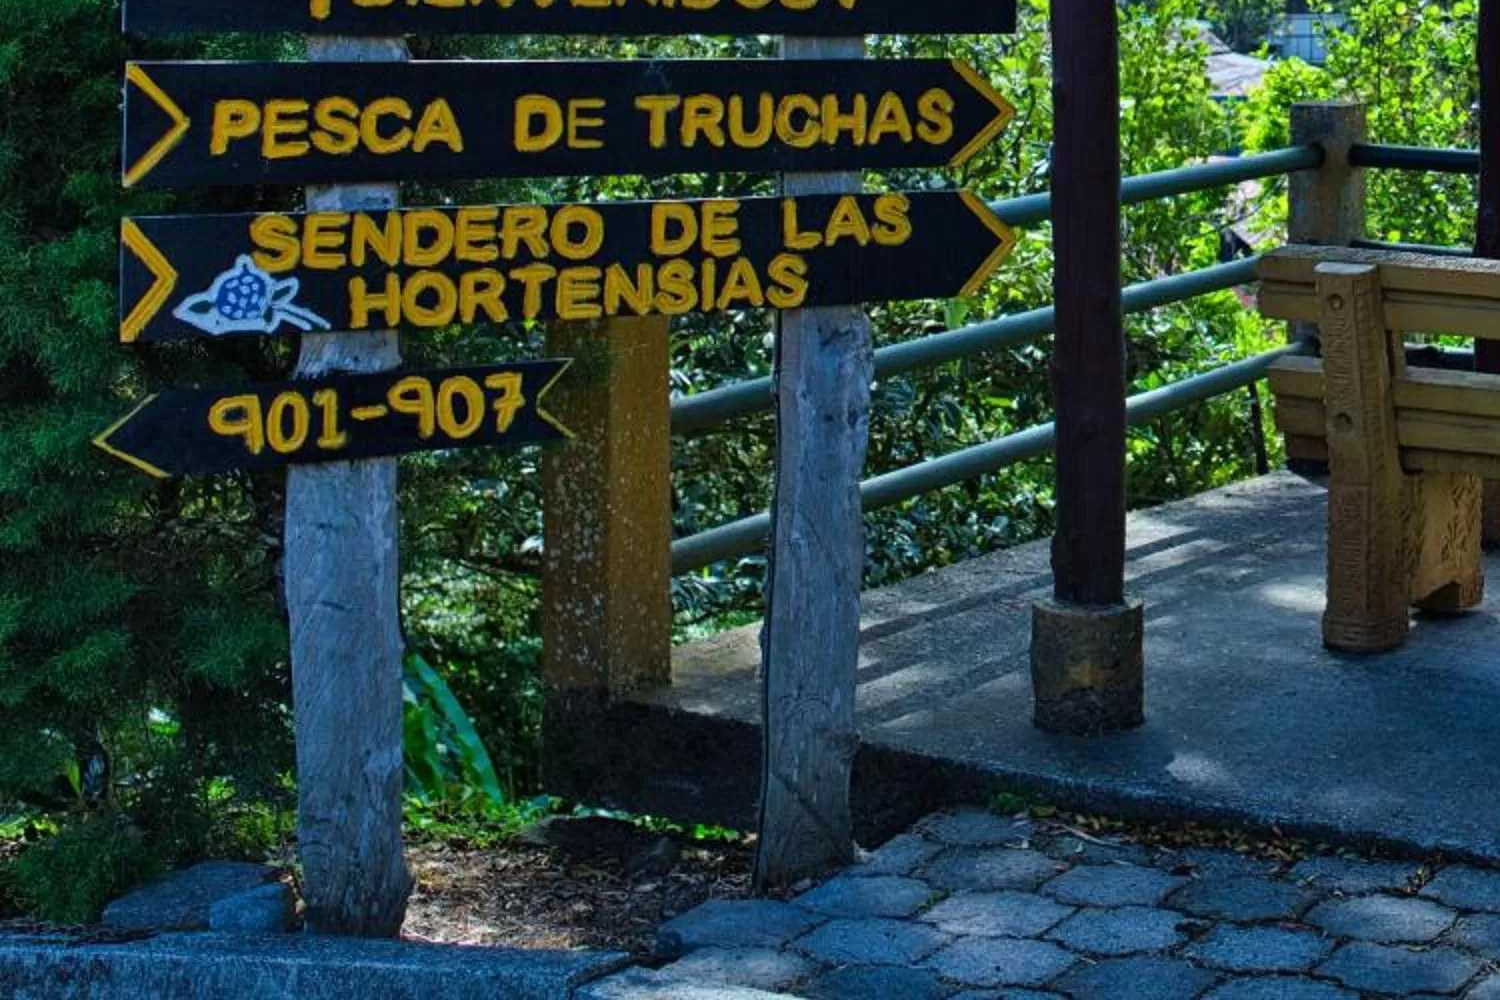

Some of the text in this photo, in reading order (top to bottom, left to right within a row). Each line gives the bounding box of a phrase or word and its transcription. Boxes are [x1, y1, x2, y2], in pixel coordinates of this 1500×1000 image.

[209, 91, 954, 159] PESCA DE TRUCHAS
[249, 194, 912, 273] SENDERO DE LAS
[348, 252, 809, 329] HORTENSIAS
[207, 371, 525, 454] 901-907
